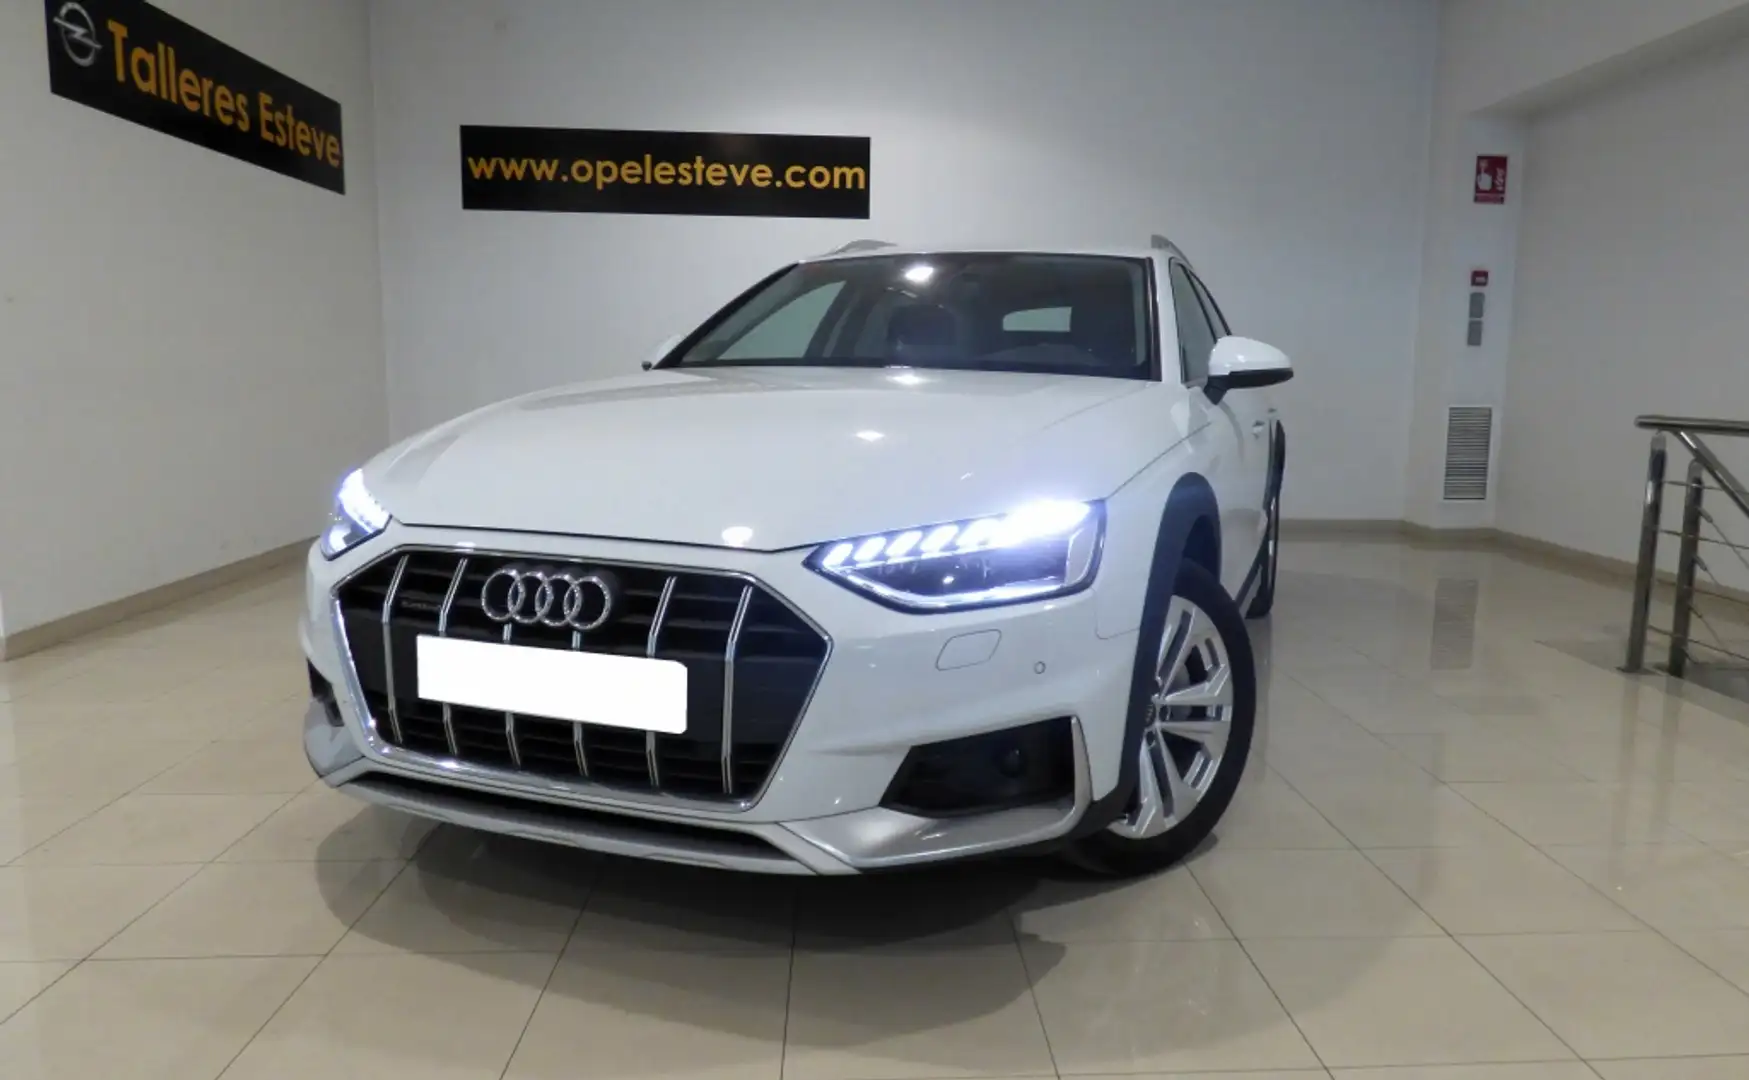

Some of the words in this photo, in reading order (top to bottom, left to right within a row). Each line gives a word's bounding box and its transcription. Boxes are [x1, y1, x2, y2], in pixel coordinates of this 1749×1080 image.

[107, 19, 249, 132] Talleres
[258, 92, 340, 168] Esteve
[467, 154, 866, 190] www.opelesteve.com
